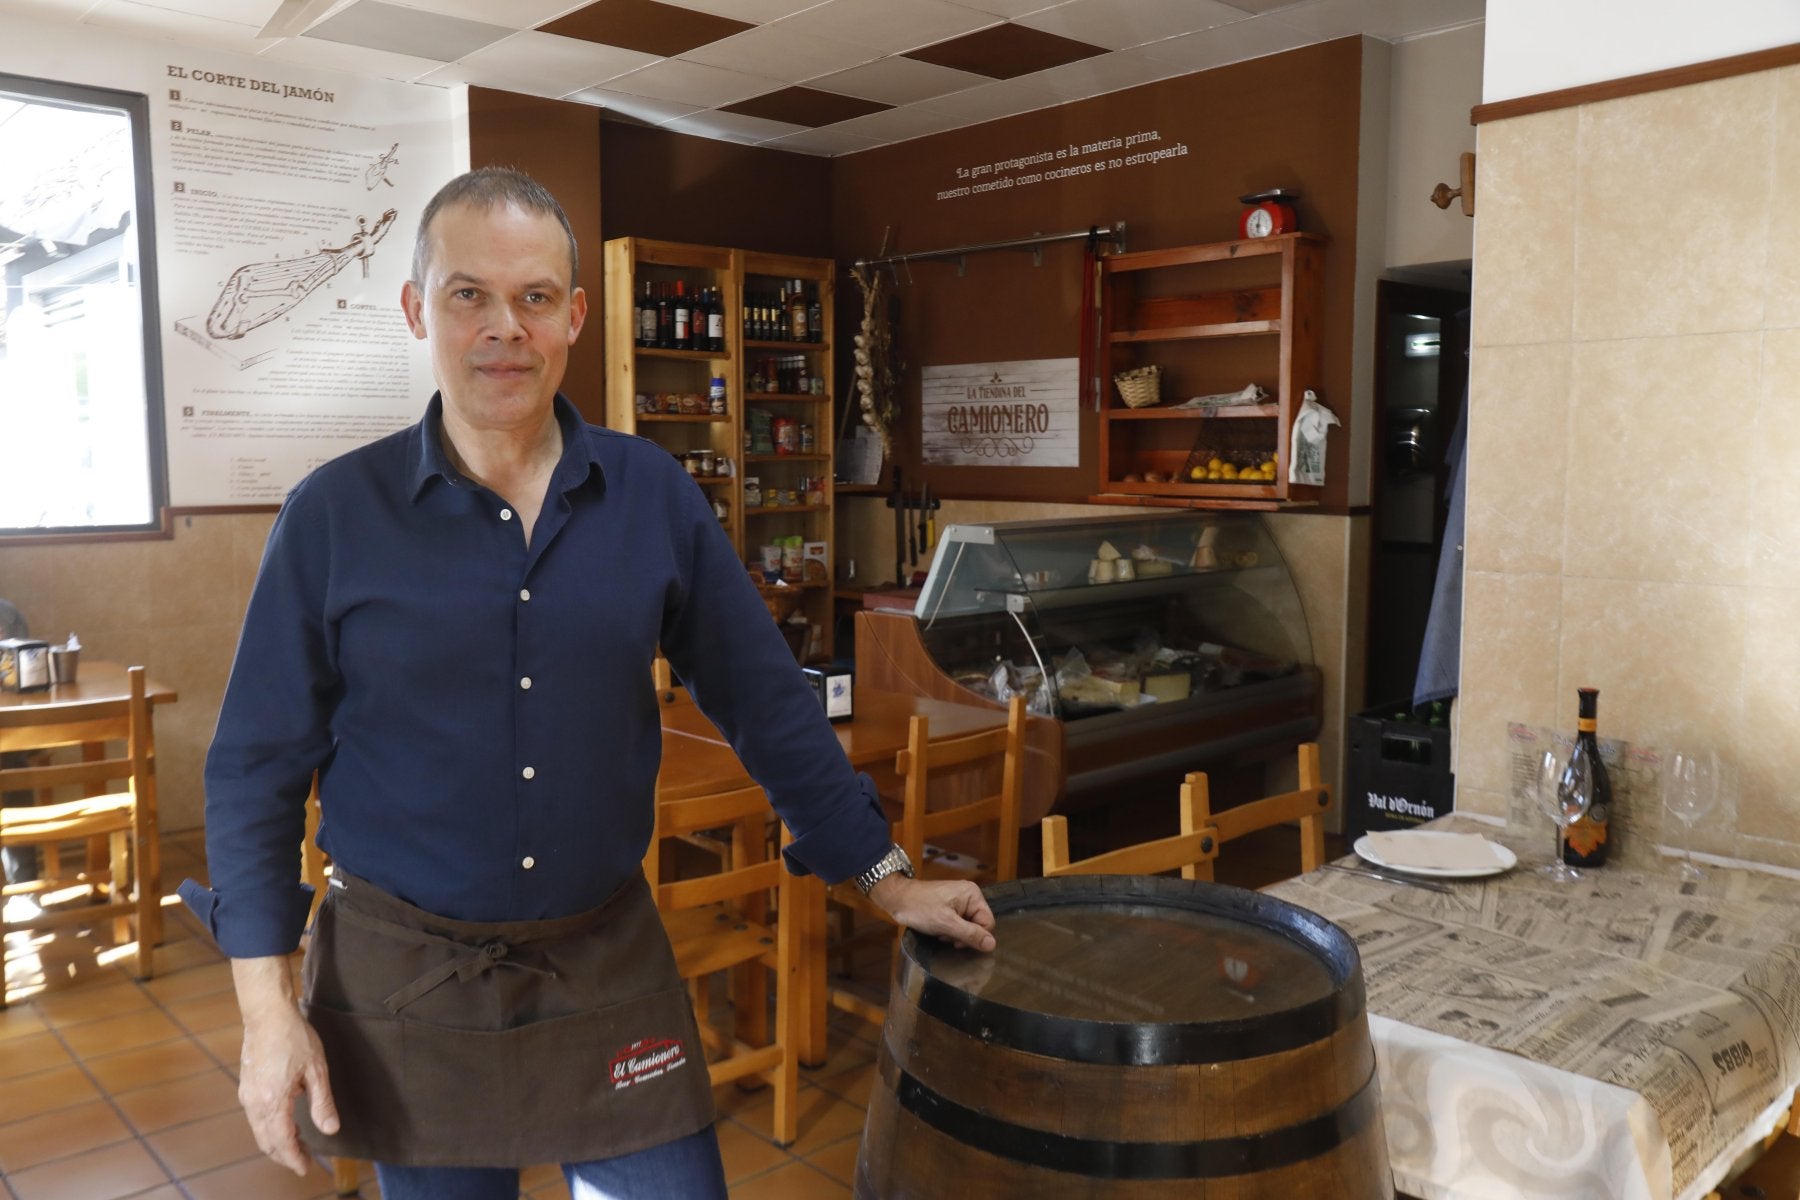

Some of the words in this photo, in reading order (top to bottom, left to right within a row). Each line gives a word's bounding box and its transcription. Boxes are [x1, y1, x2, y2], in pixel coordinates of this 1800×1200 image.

[168, 65, 188, 79] EL
[191, 70, 246, 88] CORTE
[250, 79, 280, 94] DEL
[283, 84, 335, 103] JAMÓN
[972, 163, 993, 178] gran
[994, 151, 1053, 174] protagonista
[1056, 147, 1067, 159] es
[1069, 144, 1079, 156] la
[1082, 136, 1122, 154] materia
[1125, 128, 1161, 148] prima,
[937, 183, 970, 200] nuestro
[972, 176, 1014, 194] cometido
[1016, 172, 1042, 186] como
[1044, 163, 1092, 180] cocineros
[1095, 160, 1106, 171] es
[1108, 157, 1122, 168] no
[1125, 143, 1188, 166] estropearla
[967, 387, 976, 399] LA
[978, 386, 1011, 398] TIENDINA
[1013, 386, 1026, 397] DEL
[947, 403, 1049, 434] CAMIONERO
[1367, 792, 1386, 810] Val
[614, 1061, 626, 1079] El
[628, 1045, 680, 1073] Camionero
[1712, 1040, 1754, 1076] GIBBS
